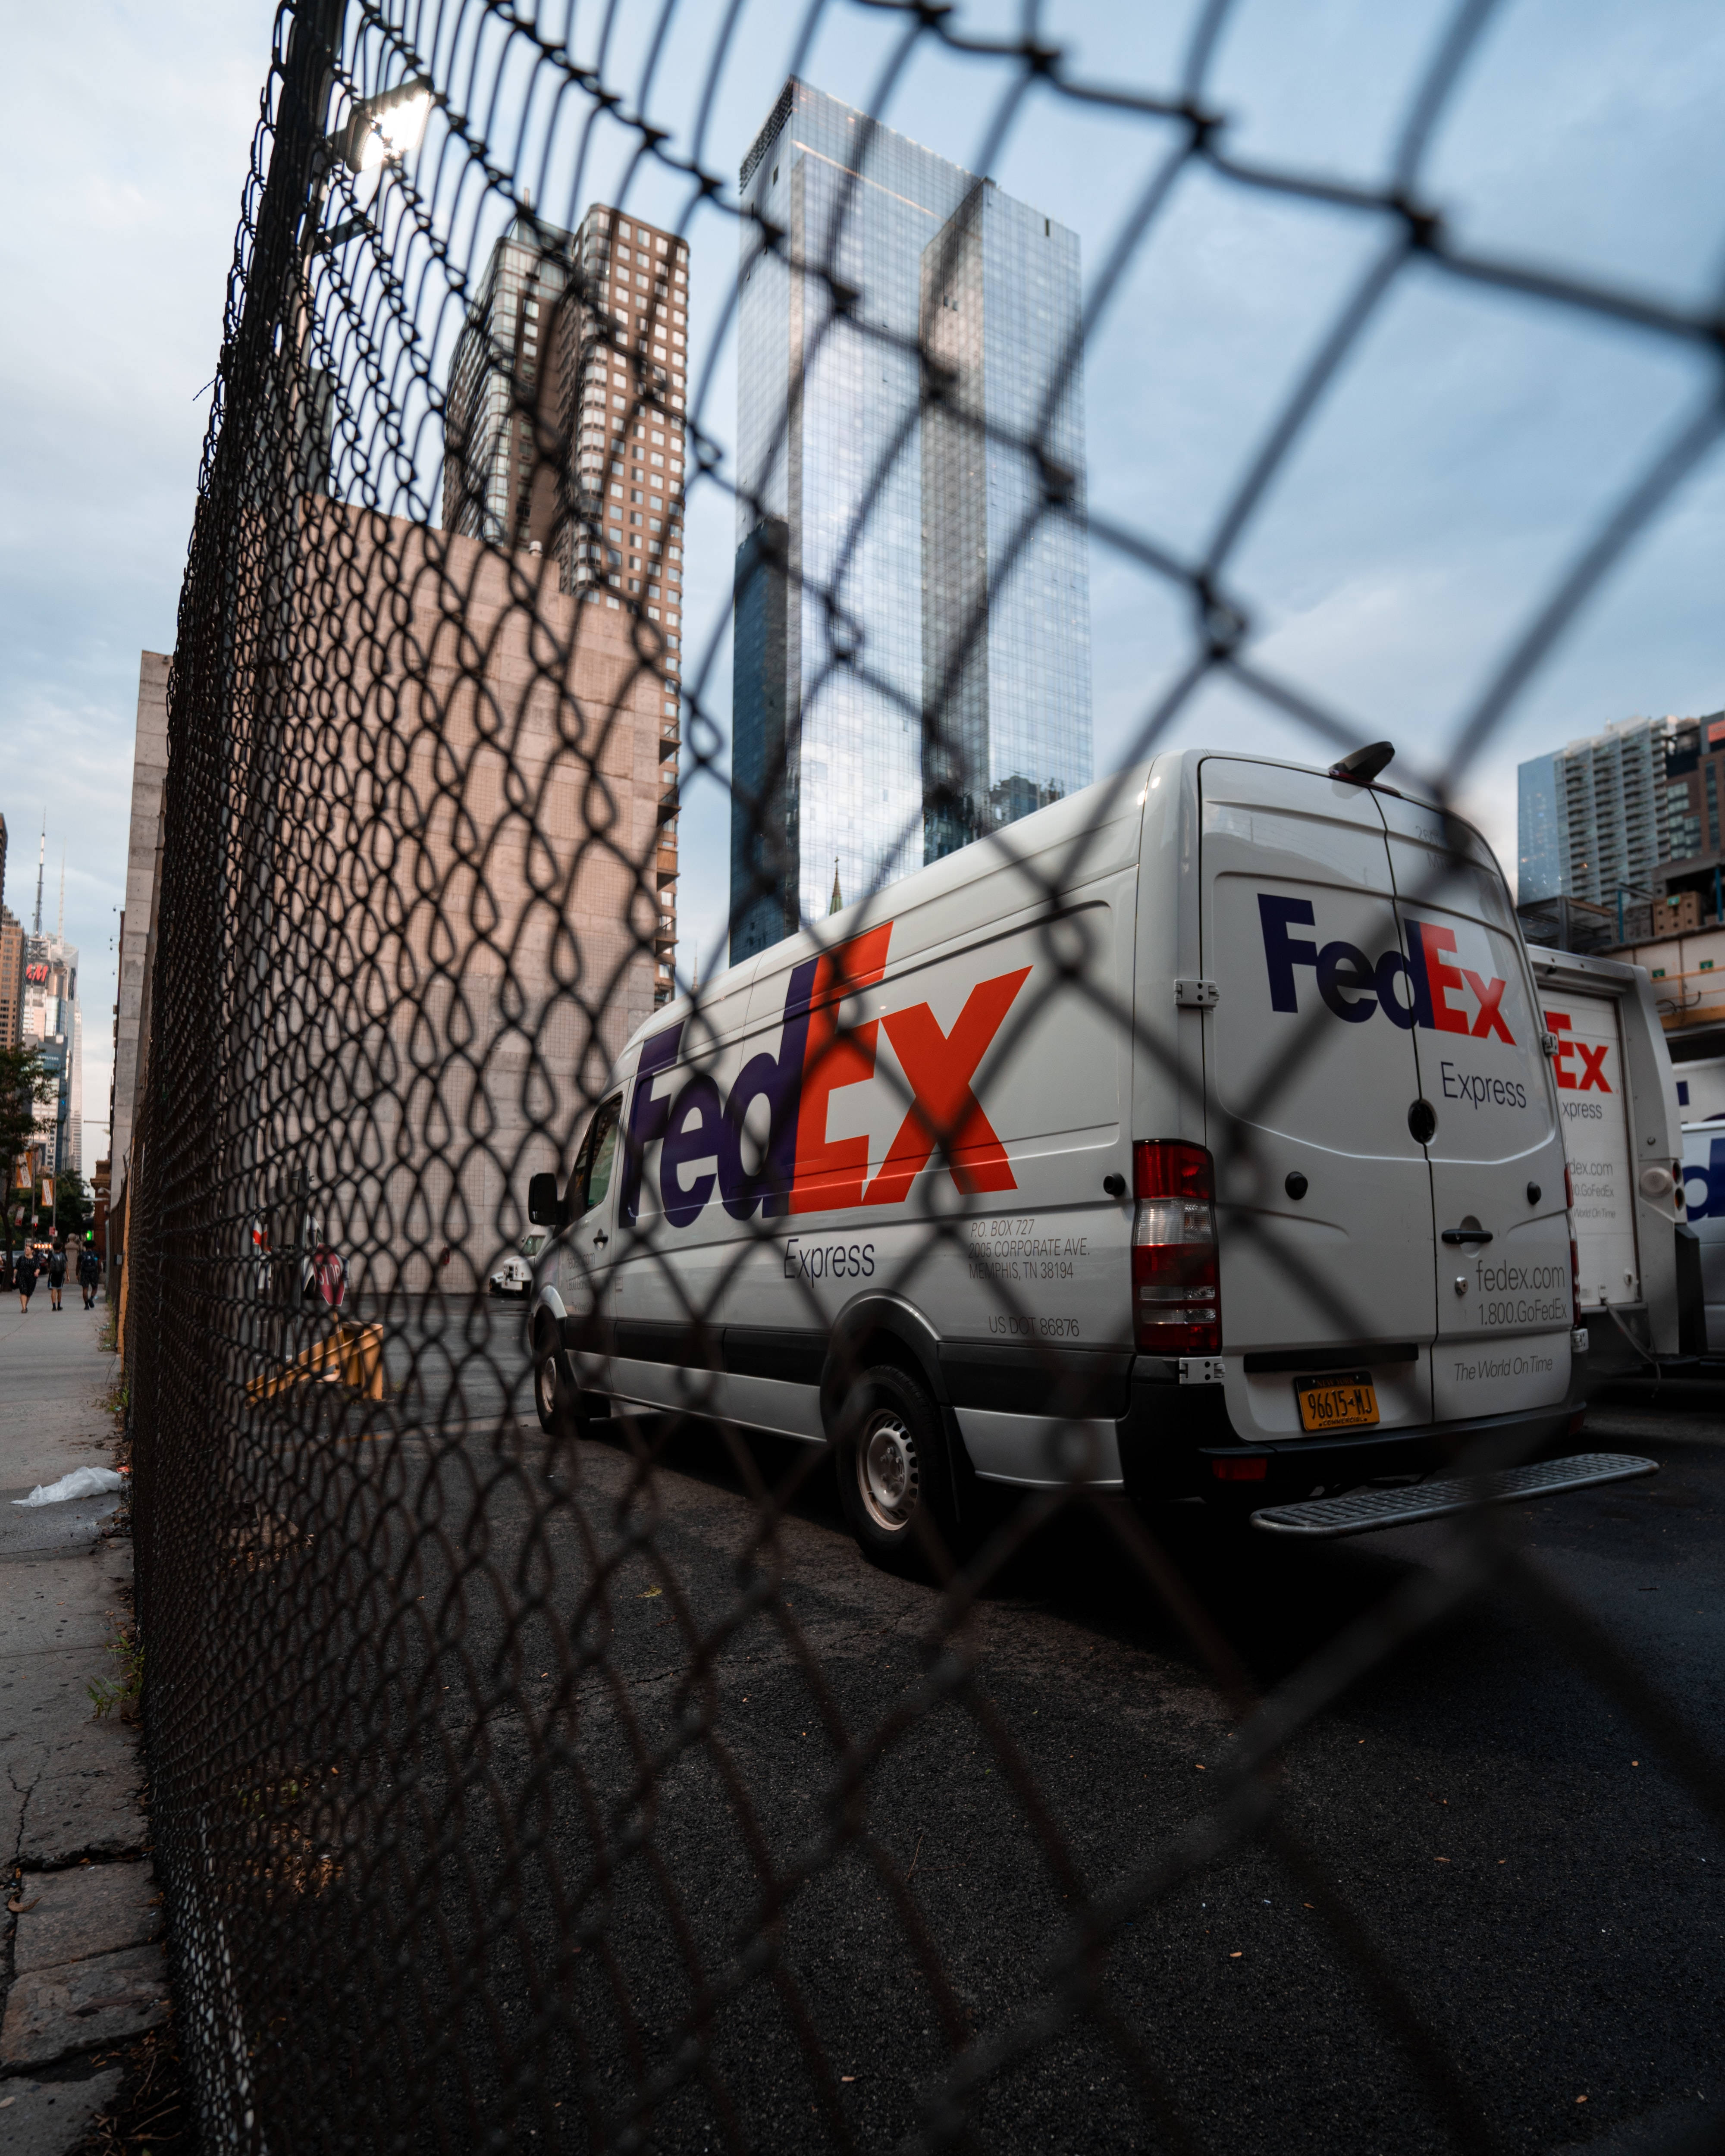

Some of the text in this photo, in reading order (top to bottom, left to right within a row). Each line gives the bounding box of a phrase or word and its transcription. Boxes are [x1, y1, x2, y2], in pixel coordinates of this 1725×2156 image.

[1257, 893, 1517, 1047] FedEx
[1543, 1010, 1613, 1094] Ex
[619, 921, 1034, 1228] FedEx
[1441, 1061, 1527, 1109] Express
[1562, 1102, 1603, 1121] xpress
[1569, 1157, 1613, 1176] dex.com
[971, 1219, 1035, 1237] P.O. BOX 727
[969, 1238, 1090, 1259] 2005 CORPORATE AVE.
[784, 1238, 875, 1288] Express
[969, 1262, 1074, 1281] MEMPHIS, TN 38194
[1476, 1259, 1565, 1291] fedex.com
[1479, 1297, 1568, 1326] 1.800.GoFedEx
[988, 1316, 1080, 1337] US DOT 86876
[1454, 1355, 1553, 1382] The World On Time
[1317, 1376, 1355, 1388] NEW YORK
[1323, 1415, 1364, 1426] COMMERCIAL
